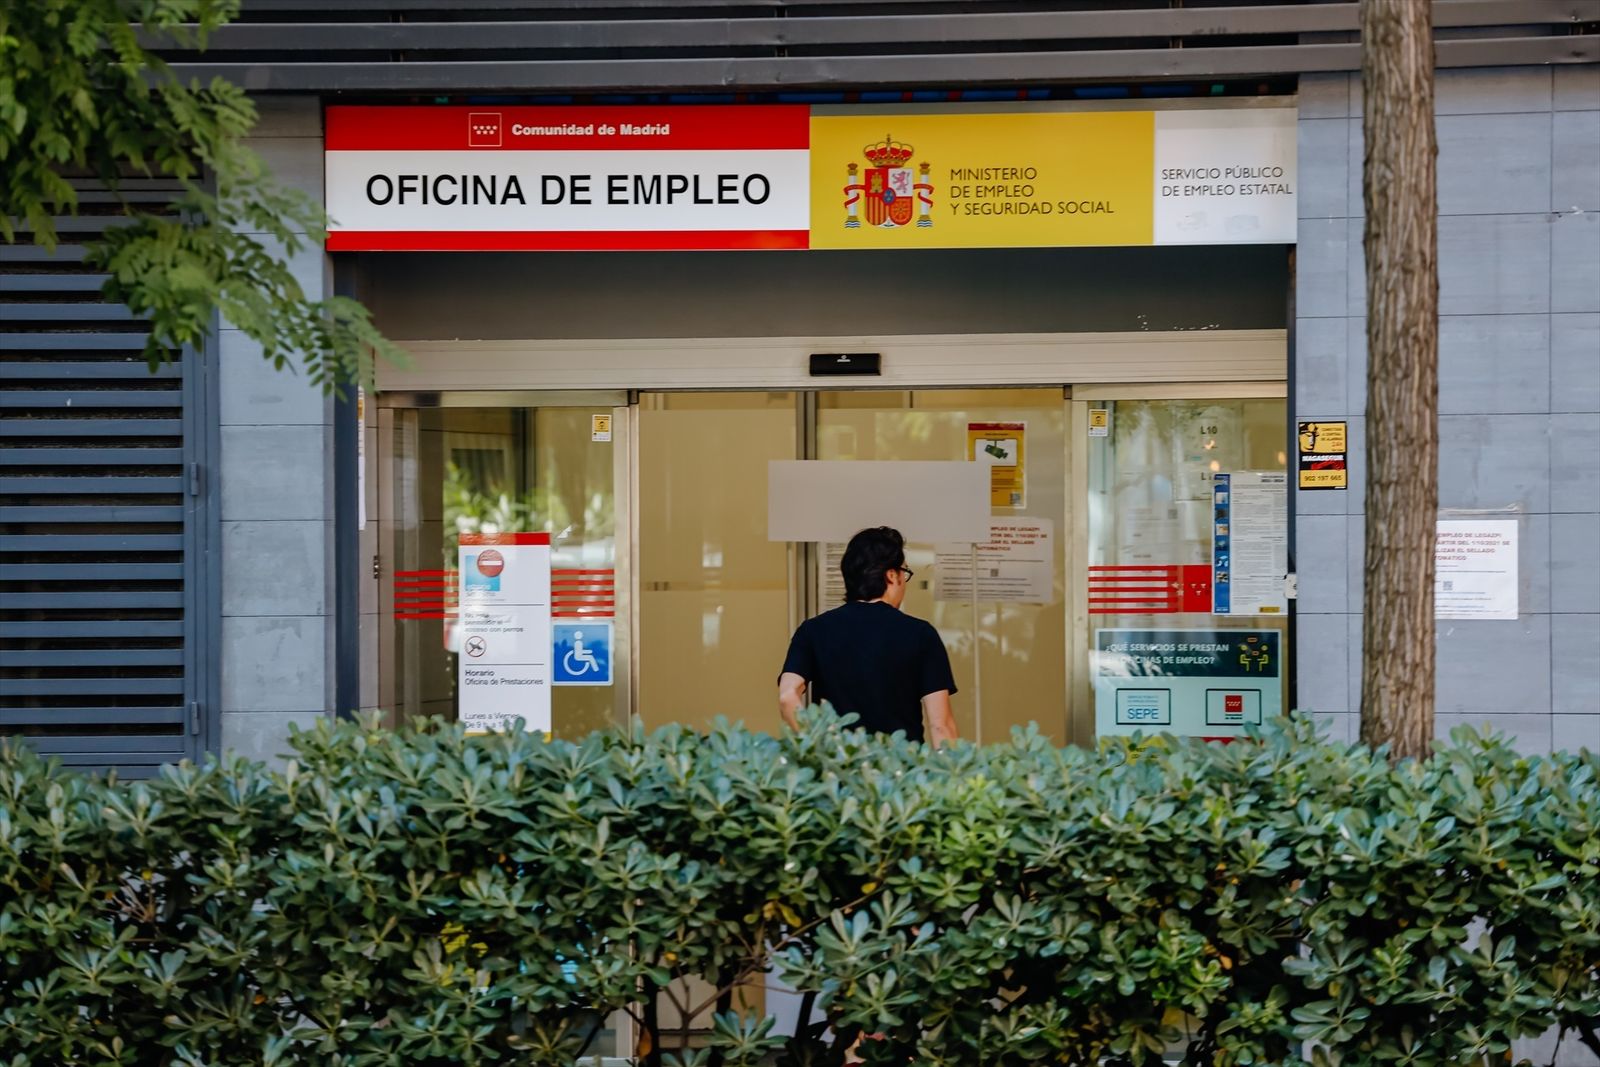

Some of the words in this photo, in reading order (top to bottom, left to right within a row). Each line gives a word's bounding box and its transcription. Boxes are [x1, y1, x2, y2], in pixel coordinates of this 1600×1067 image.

[511, 123, 594, 136] Comunidad
[597, 123, 615, 136] de
[619, 123, 670, 136] Madrid
[950, 167, 1037, 181] MINISTERIO
[1162, 167, 1221, 180] SERVICIO
[1225, 163, 1284, 179] PÚBLICO
[366, 174, 526, 206] OFICINA
[541, 174, 592, 205] DE
[607, 173, 771, 206] EMPLEO
[950, 186, 971, 198] DE
[975, 184, 1034, 198] EMPLEO
[1162, 185, 1180, 197] DE
[1184, 184, 1235, 197] EMPLEO
[1240, 183, 1293, 196] ESTATAL
[950, 204, 960, 216] Y
[964, 202, 1053, 216] SEGURIDAD
[1058, 201, 1115, 214] SOCIAL
[1178, 644, 1189, 652] SE
[1190, 644, 1230, 652] PRESTAN
[1163, 657, 1174, 665] DE
[1176, 656, 1216, 665] EMPLEO?
[465, 678, 489, 686] Oficina
[490, 678, 499, 686] de
[1127, 708, 1159, 720] SEPE
